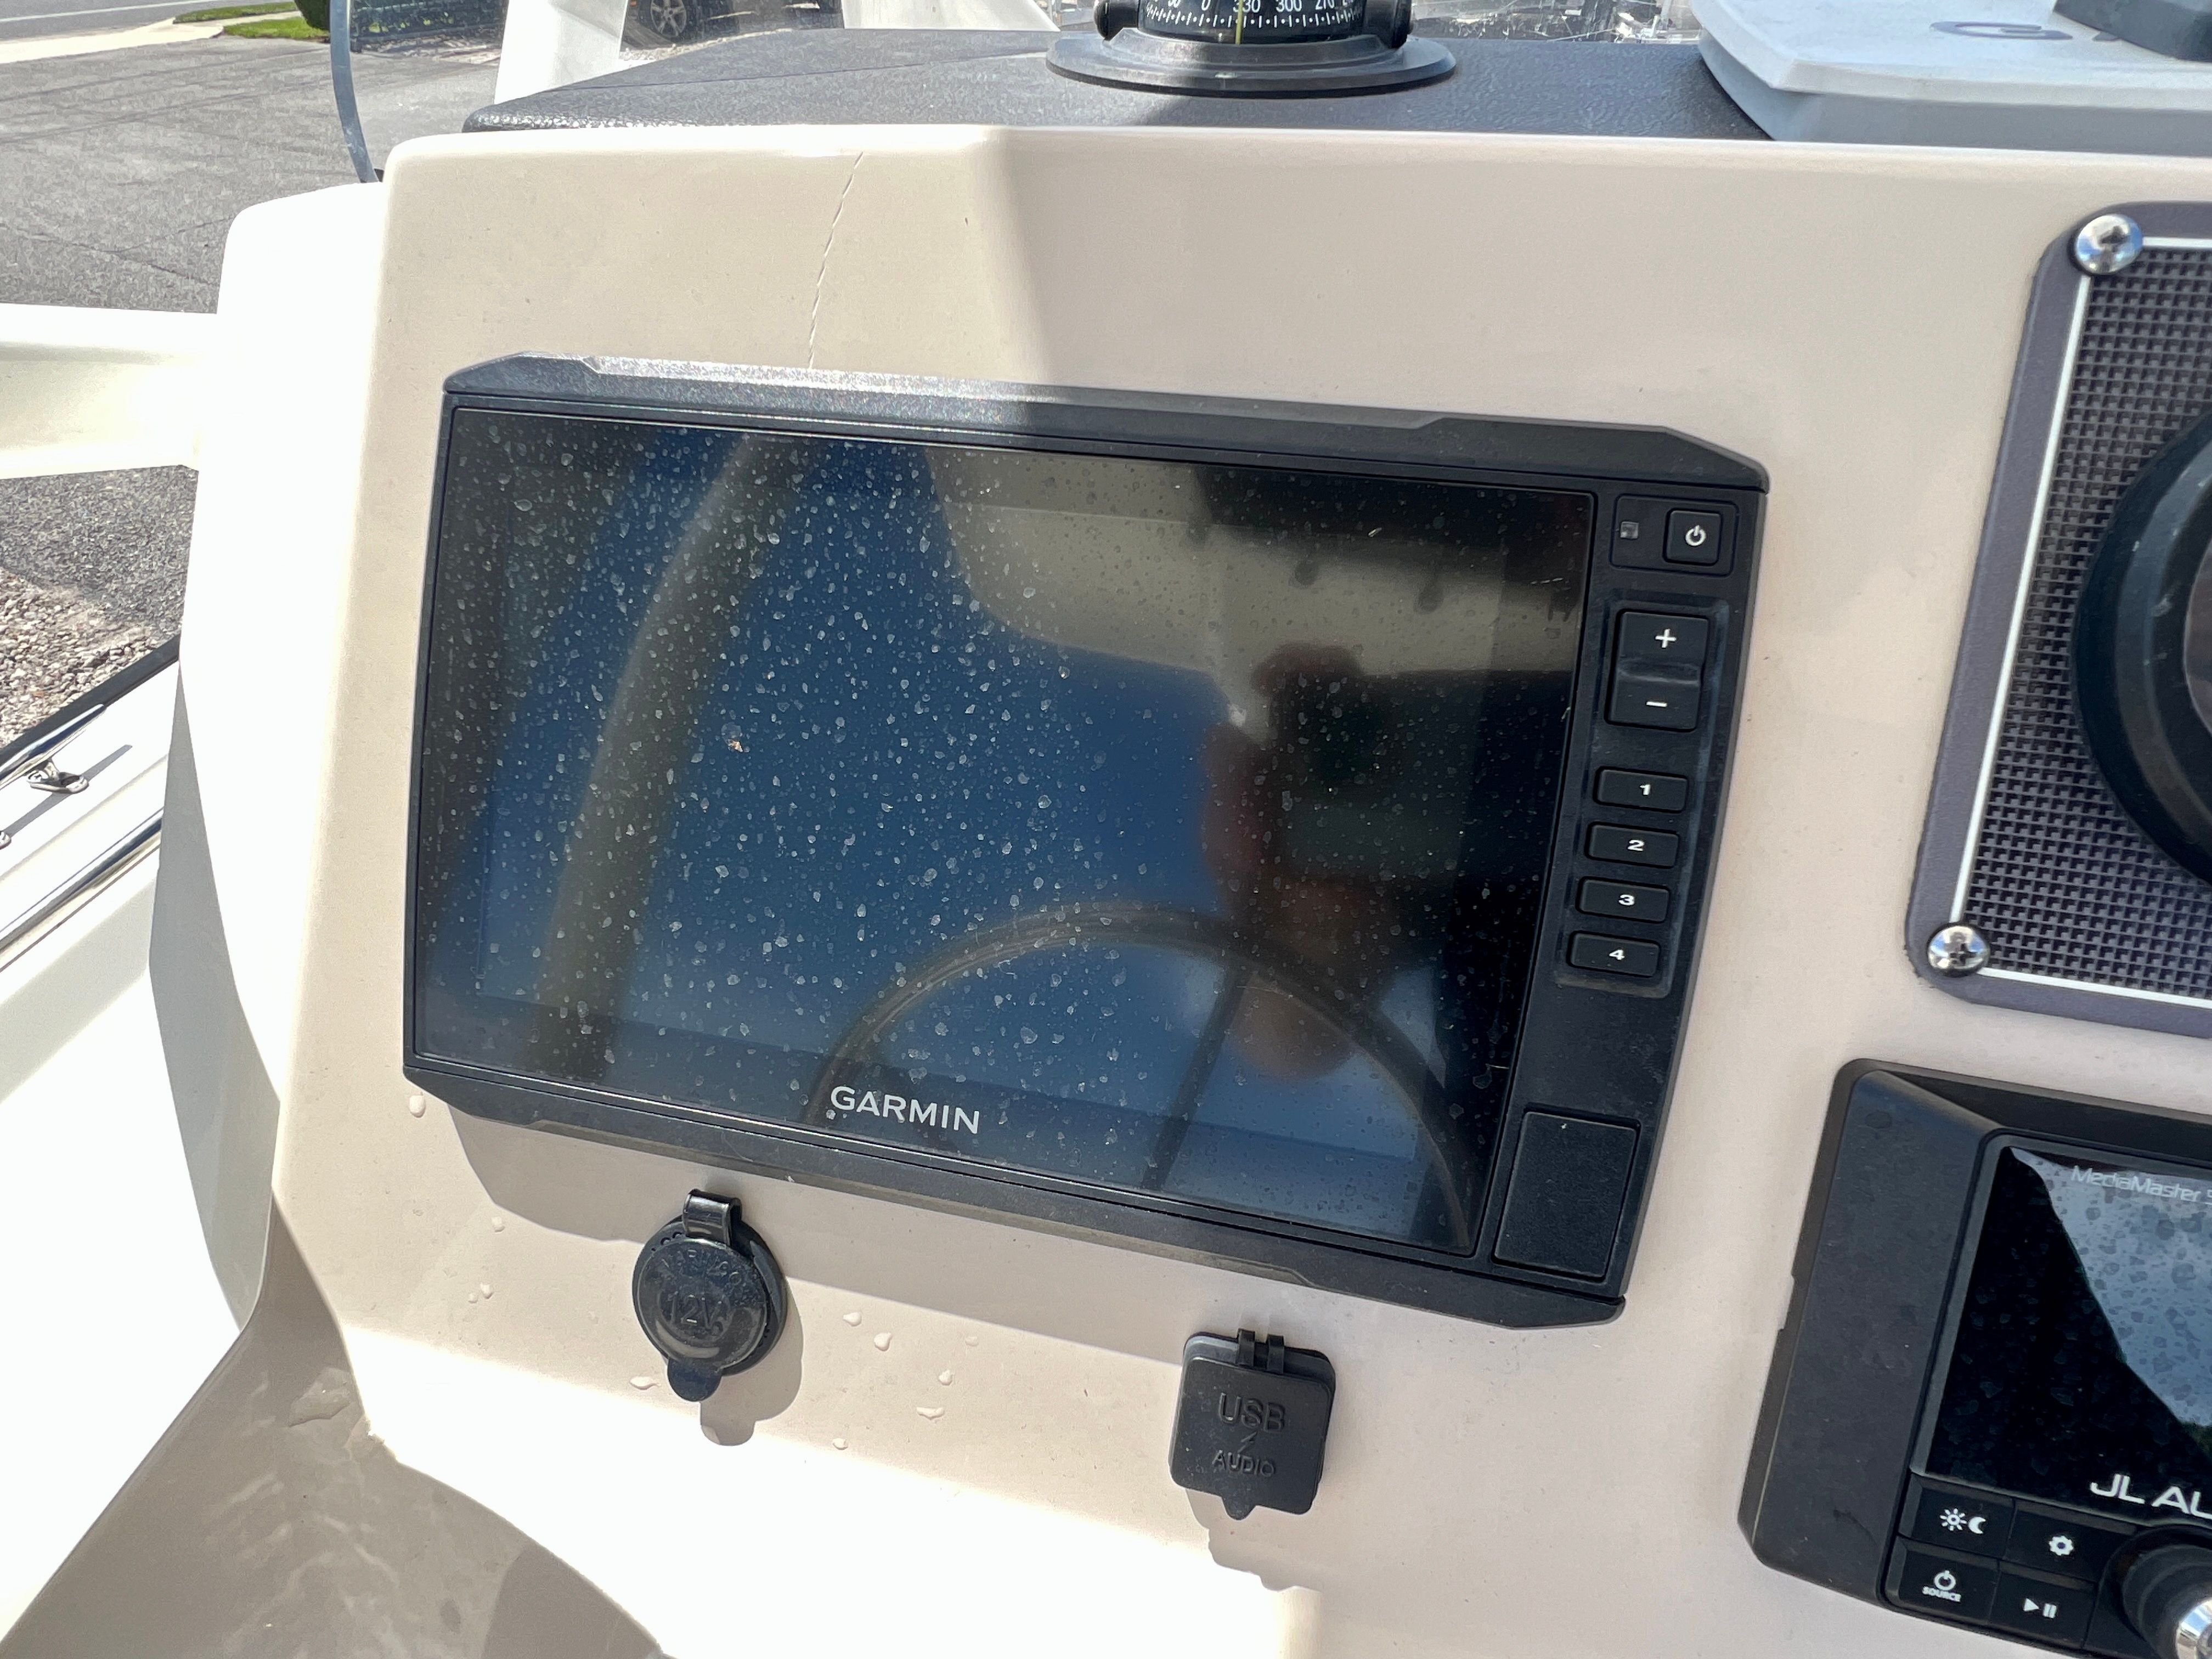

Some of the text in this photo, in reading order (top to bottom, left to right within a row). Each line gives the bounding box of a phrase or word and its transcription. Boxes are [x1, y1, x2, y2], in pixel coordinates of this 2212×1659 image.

[1276, 0, 1302, 12] 300
[1639, 783, 1652, 796] 1
[1627, 839, 1645, 852] 2
[1618, 894, 1635, 906] 3
[1609, 949, 1625, 961] 4
[830, 1085, 980, 1135] GARMIN
[2070, 1165, 2202, 1203] MediaMaster
[1218, 1392, 1285, 1433] USB
[1211, 1449, 1276, 1477] AUDIO
[2090, 1473, 2145, 1505] JL
[1922, 1586, 1962, 1602] SOURCE
